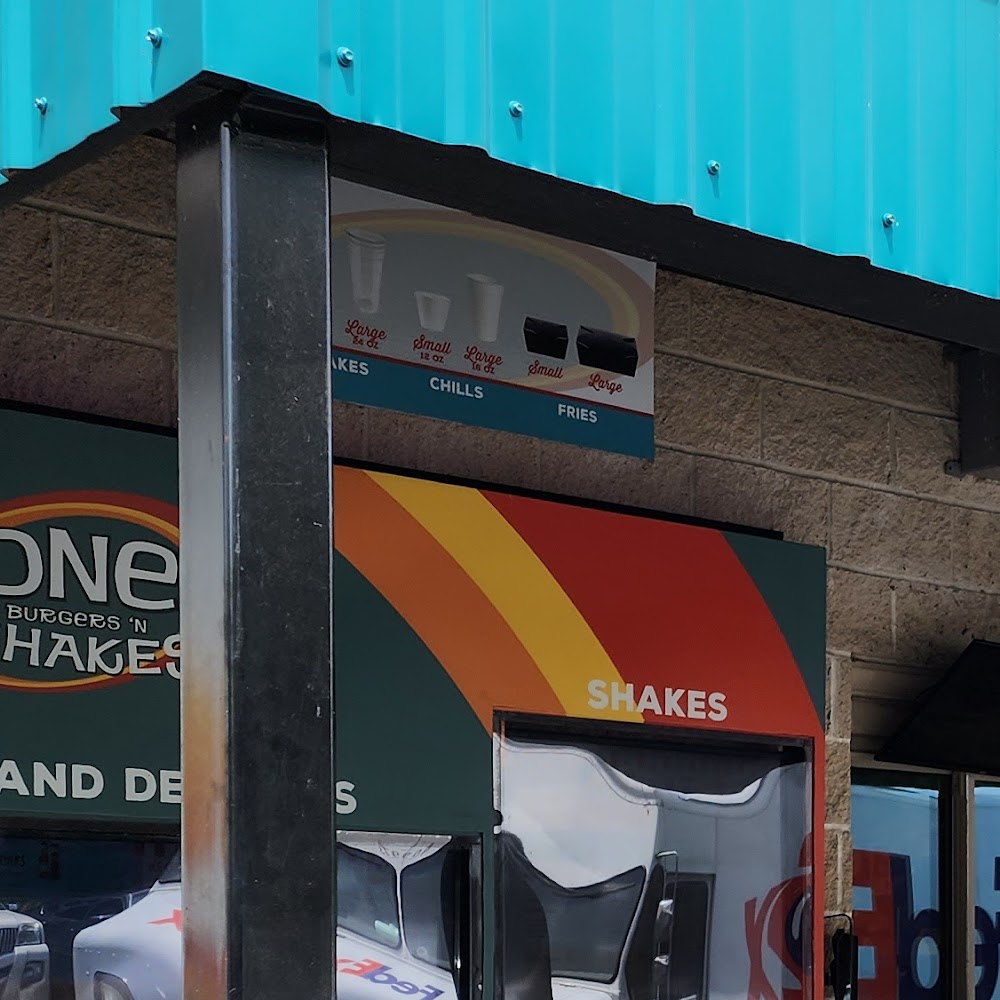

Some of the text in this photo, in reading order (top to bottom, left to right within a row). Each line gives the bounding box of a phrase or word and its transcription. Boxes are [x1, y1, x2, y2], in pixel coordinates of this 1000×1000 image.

[345, 320, 387, 341] Large
[413, 334, 451, 354] Small
[420, 352, 444, 364] 12 OZ
[464, 346, 503, 369] Large
[528, 360, 563, 380] Small
[429, 376, 484, 399] CHILLS
[588, 373, 623, 394] Large
[557, 403, 598, 424] FRIES
[0, 527, 178, 610] ONe
[2, 622, 181, 680] HAKES
[587, 679, 728, 722] SHAKES
[0, 759, 105, 800] AND
